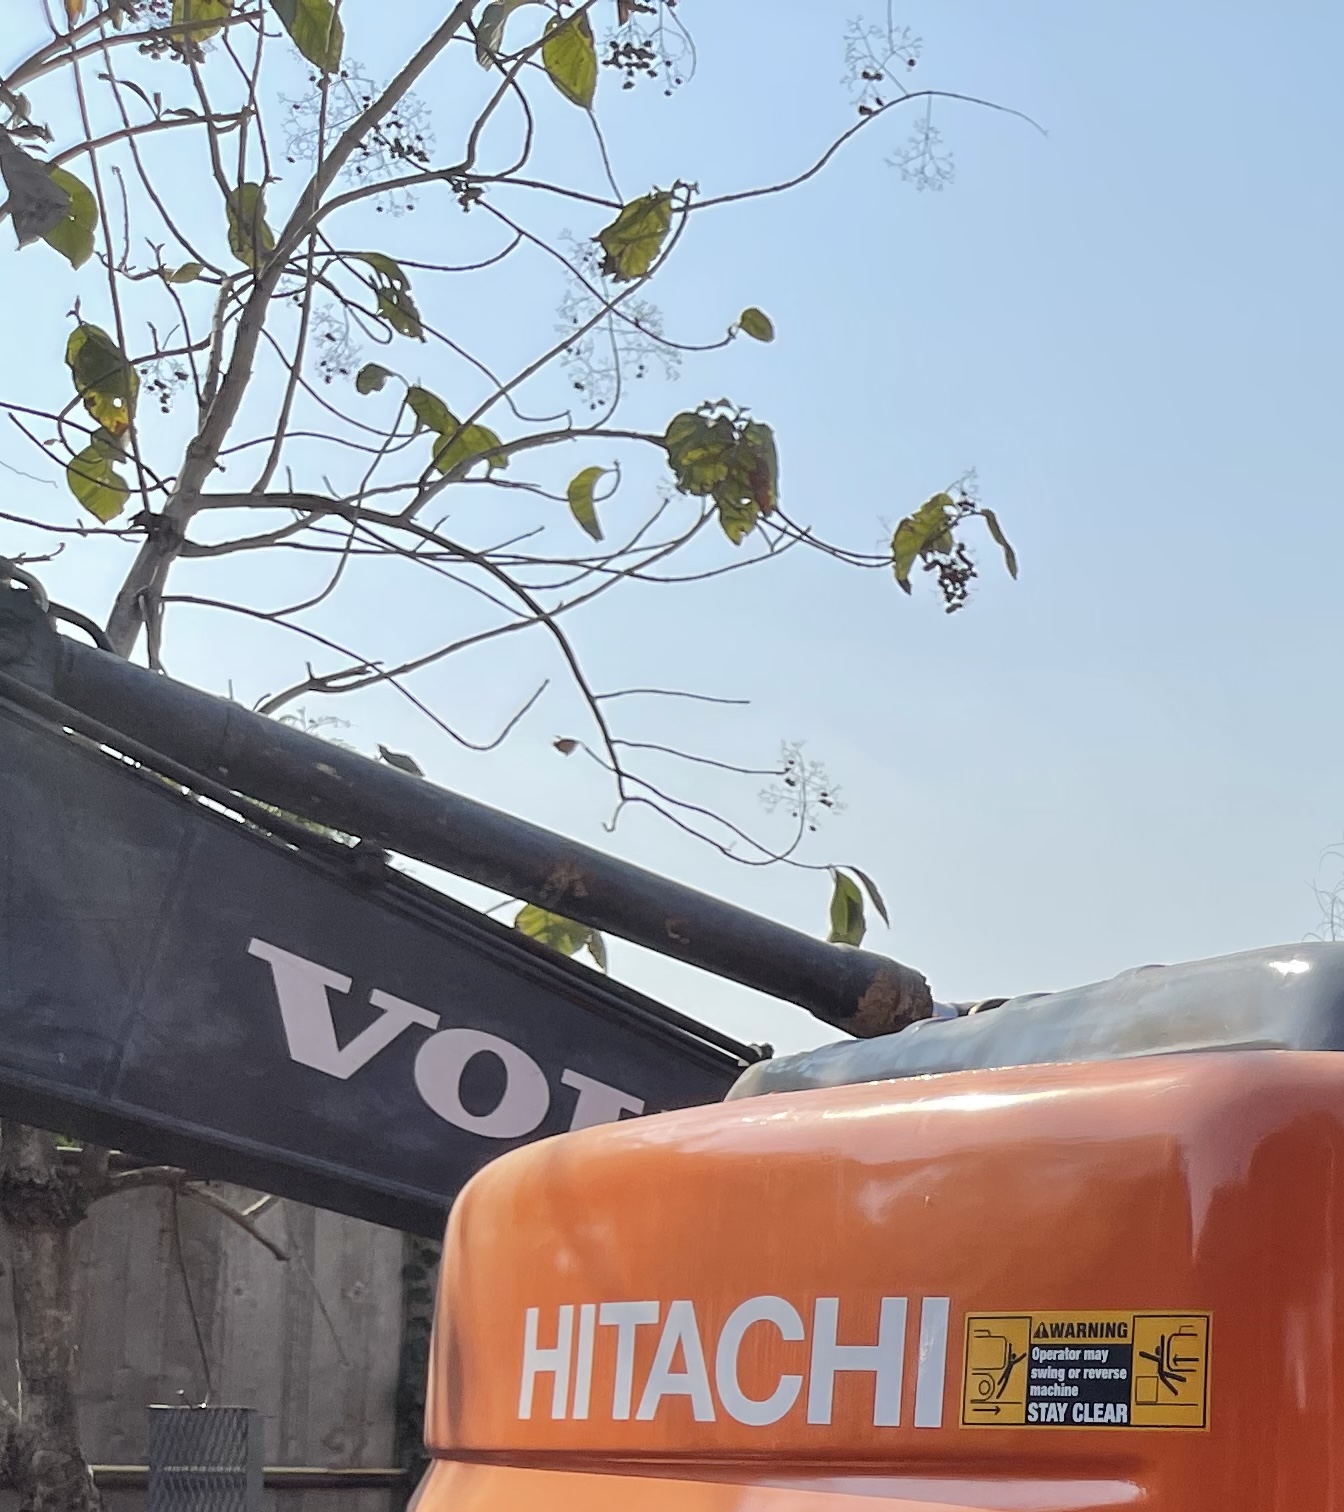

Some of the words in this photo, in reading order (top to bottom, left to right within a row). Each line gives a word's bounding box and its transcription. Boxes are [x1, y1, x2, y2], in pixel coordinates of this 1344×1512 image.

[247, 936, 672, 1139] VO
[1049, 1322, 1129, 1339] WARNING
[518, 1295, 950, 1428] HITACHI
[1031, 1346, 1082, 1364] Operator
[1083, 1349, 1110, 1364] may
[1030, 1365, 1066, 1382] swing
[1068, 1368, 1081, 1380] or
[1083, 1368, 1128, 1380] reverse
[1029, 1383, 1079, 1397] machine
[1027, 1402, 1069, 1423] STAY
[1072, 1402, 1129, 1424] CLEAR
